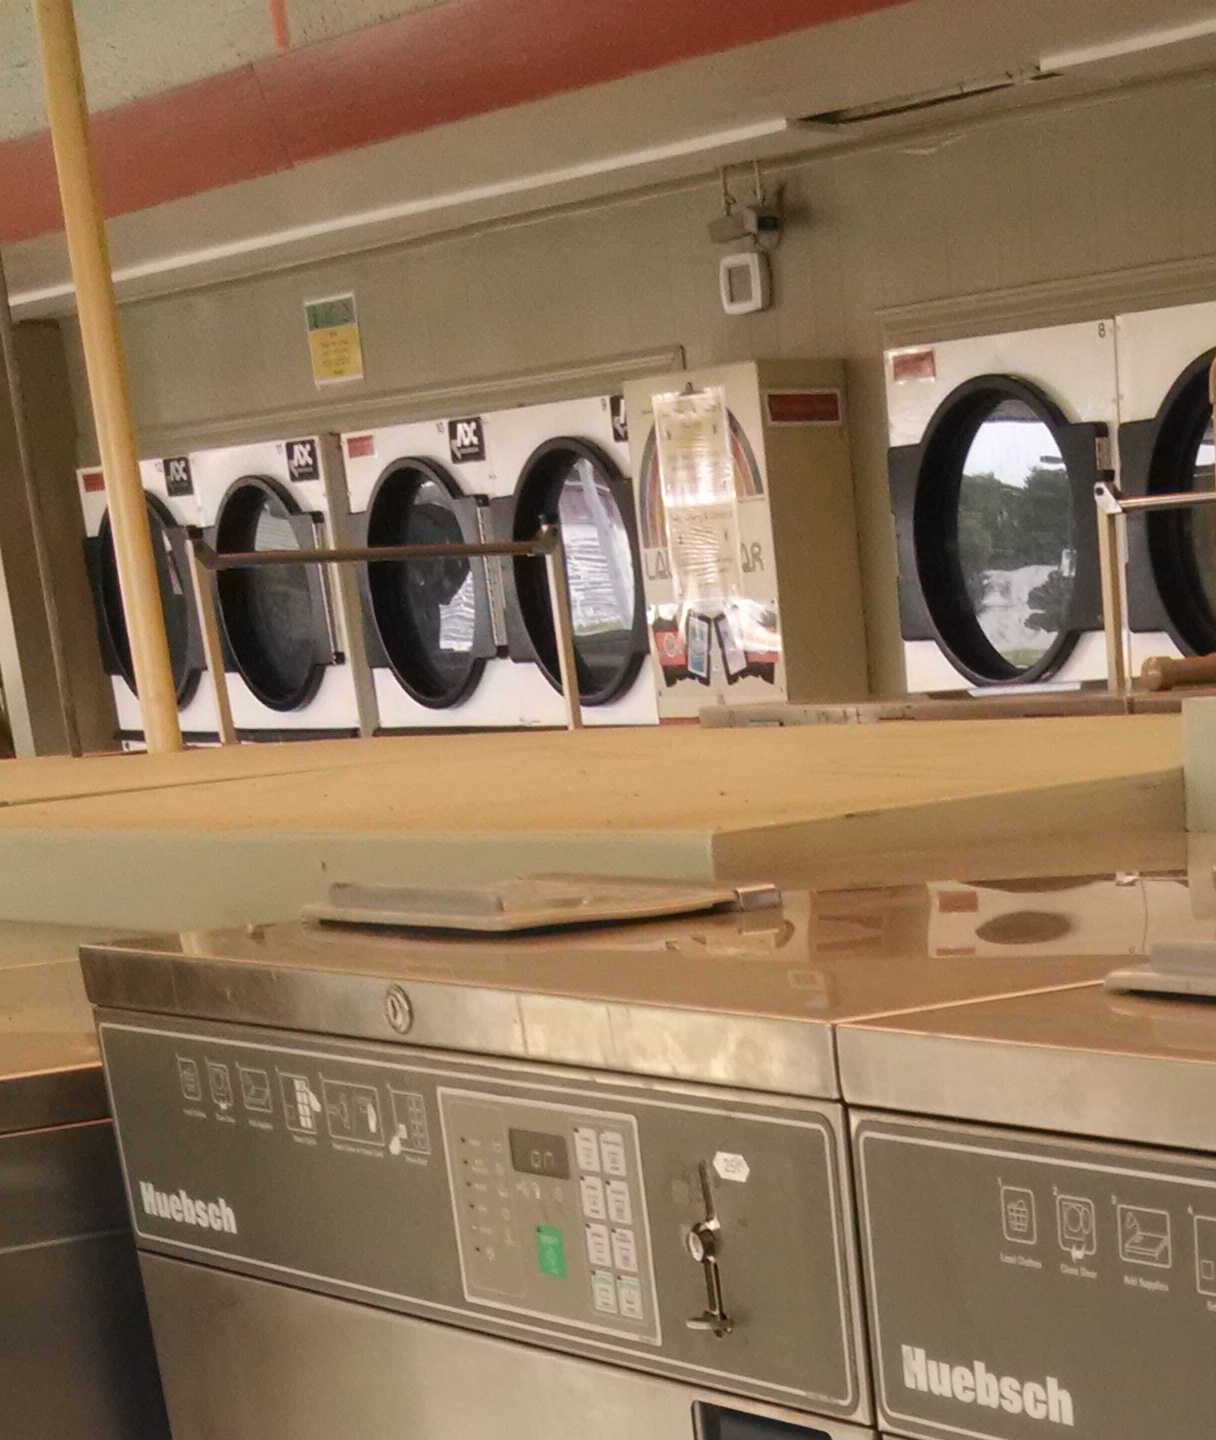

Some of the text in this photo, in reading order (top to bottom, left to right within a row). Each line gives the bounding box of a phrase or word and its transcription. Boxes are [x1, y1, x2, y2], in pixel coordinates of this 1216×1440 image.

[1097, 322, 1106, 338] 8
[139, 1180, 238, 1235] Huebsch
[901, 1344, 1075, 1427] Huebsch
